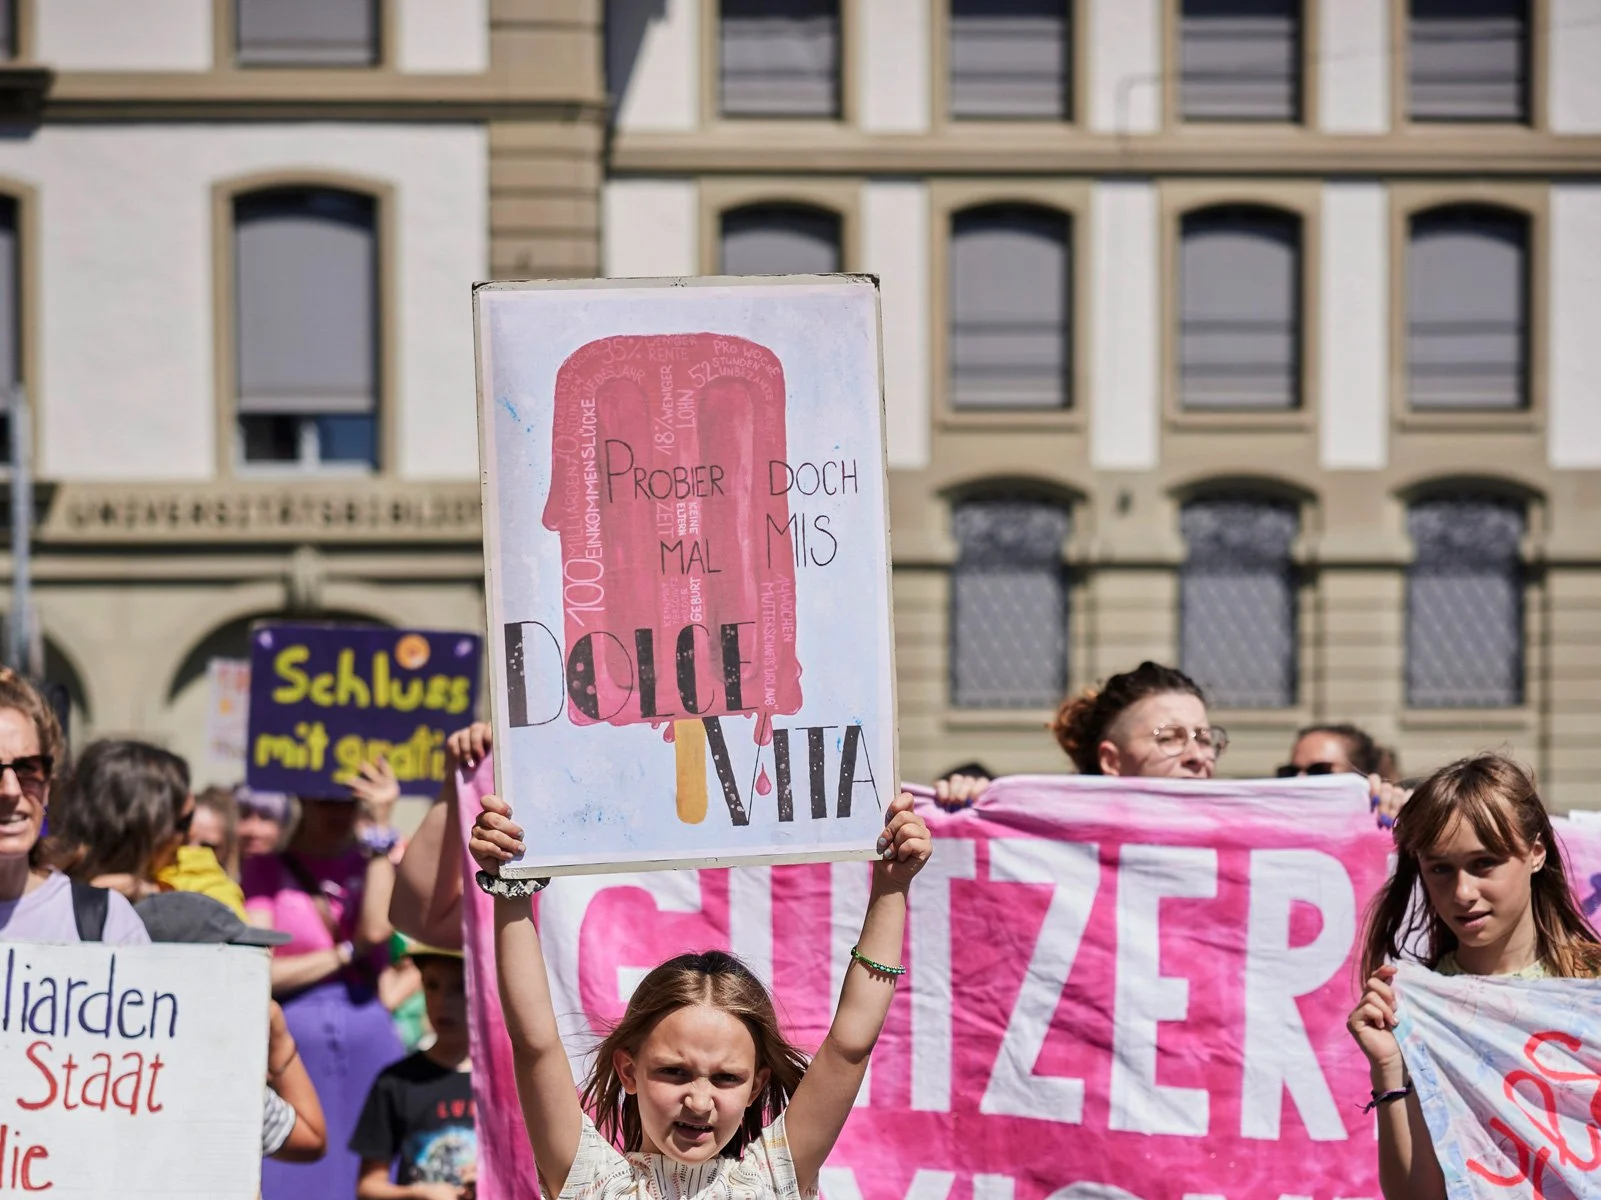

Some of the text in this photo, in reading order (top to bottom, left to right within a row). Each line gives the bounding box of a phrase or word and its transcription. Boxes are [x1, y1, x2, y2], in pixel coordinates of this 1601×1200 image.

[602, 338, 642, 364] 35%
[649, 347, 690, 362] RENTE
[687, 356, 761, 388] 52 STUNDEN
[712, 339, 739, 355] PRO
[654, 364, 677, 456] 18% WENIGER
[675, 388, 698, 428] LOHN
[605, 439, 860, 504] PROBIER DOCH
[656, 500, 675, 538] ZEIT
[660, 513, 838, 575] MAL MIS
[676, 501, 687, 537] ELTERN
[688, 501, 699, 536] KEINE
[564, 464, 606, 627] 100 MILLIARDEN
[689, 576, 703, 622] GEBURT
[272, 645, 470, 714] Schluss
[504, 620, 760, 728] DOLCE
[254, 720, 329, 773] mit
[701, 712, 882, 827] VITA
[3, 948, 179, 1040] liarden
[16, 1040, 165, 1115] Staat
